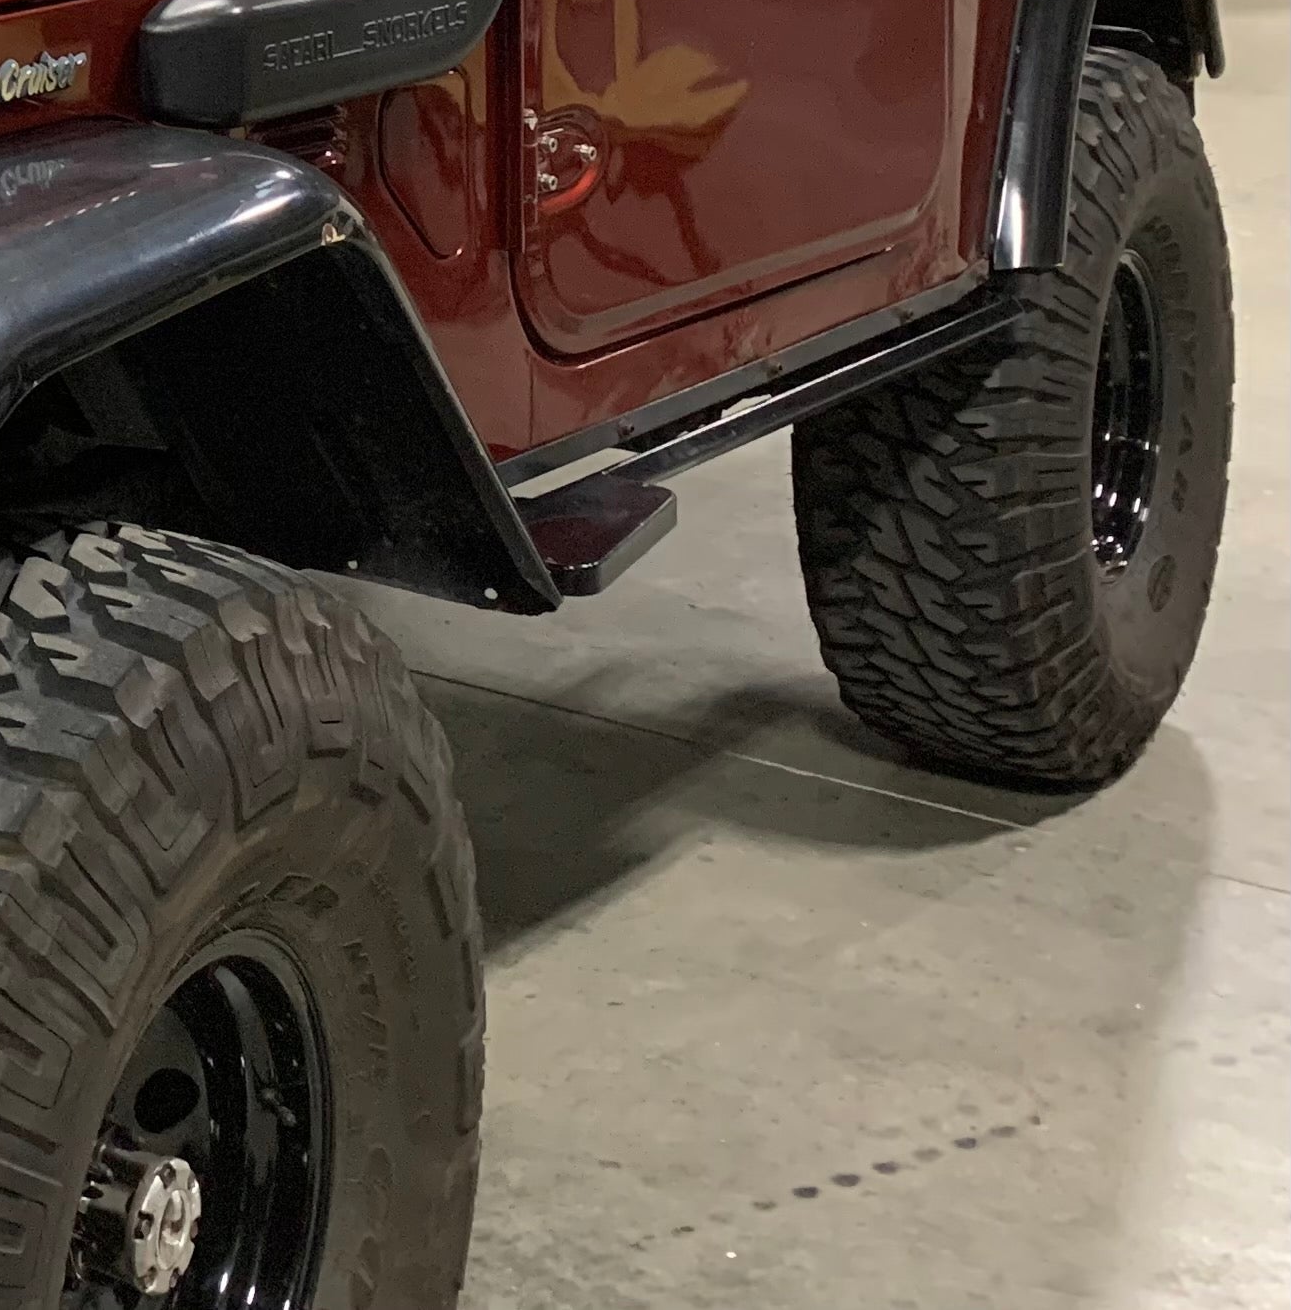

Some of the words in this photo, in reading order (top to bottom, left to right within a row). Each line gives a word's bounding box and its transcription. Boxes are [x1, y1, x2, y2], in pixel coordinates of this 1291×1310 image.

[264, 30, 334, 72] SAFARI
[362, 1, 468, 48] SNORKELS
[0, 51, 88, 103] Cruiser
